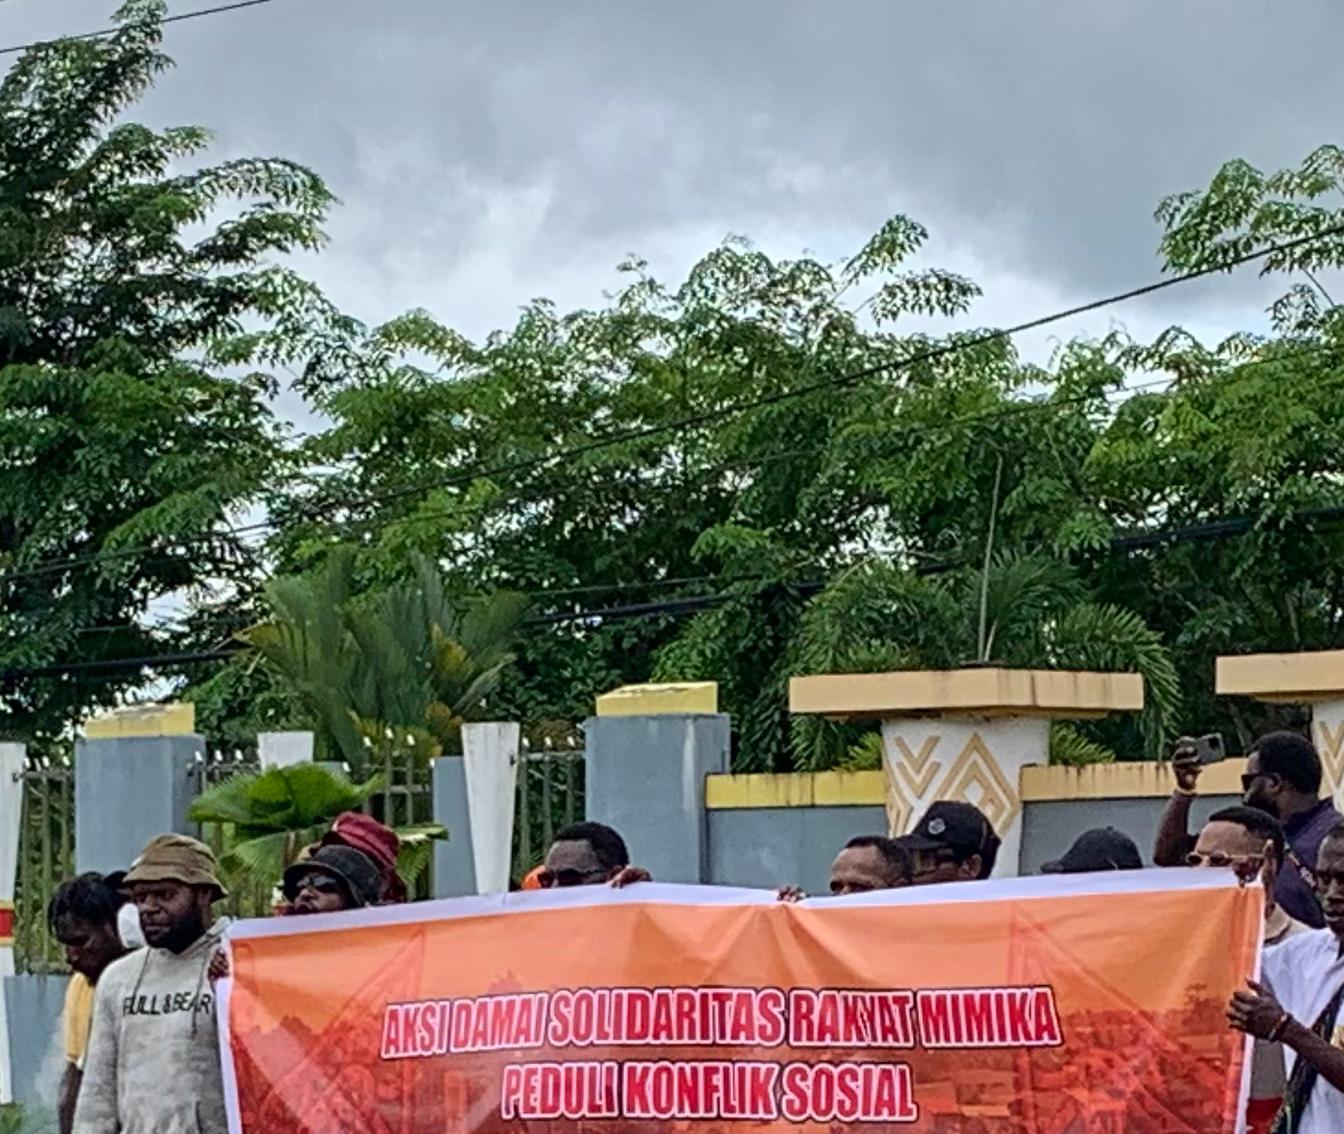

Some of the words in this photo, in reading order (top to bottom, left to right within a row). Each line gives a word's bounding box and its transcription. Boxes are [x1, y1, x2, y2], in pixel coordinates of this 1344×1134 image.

[382, 1003, 449, 1057] AKSI
[451, 994, 547, 1052] DAMAI
[549, 990, 784, 1045] SOLIDARITAS
[790, 990, 913, 1046] RAKYAT
[918, 989, 1061, 1046] MIMIKA
[503, 1063, 617, 1119] PEDULI
[624, 1063, 775, 1119] KONFLIK
[783, 1064, 917, 1121] SOSIAL
